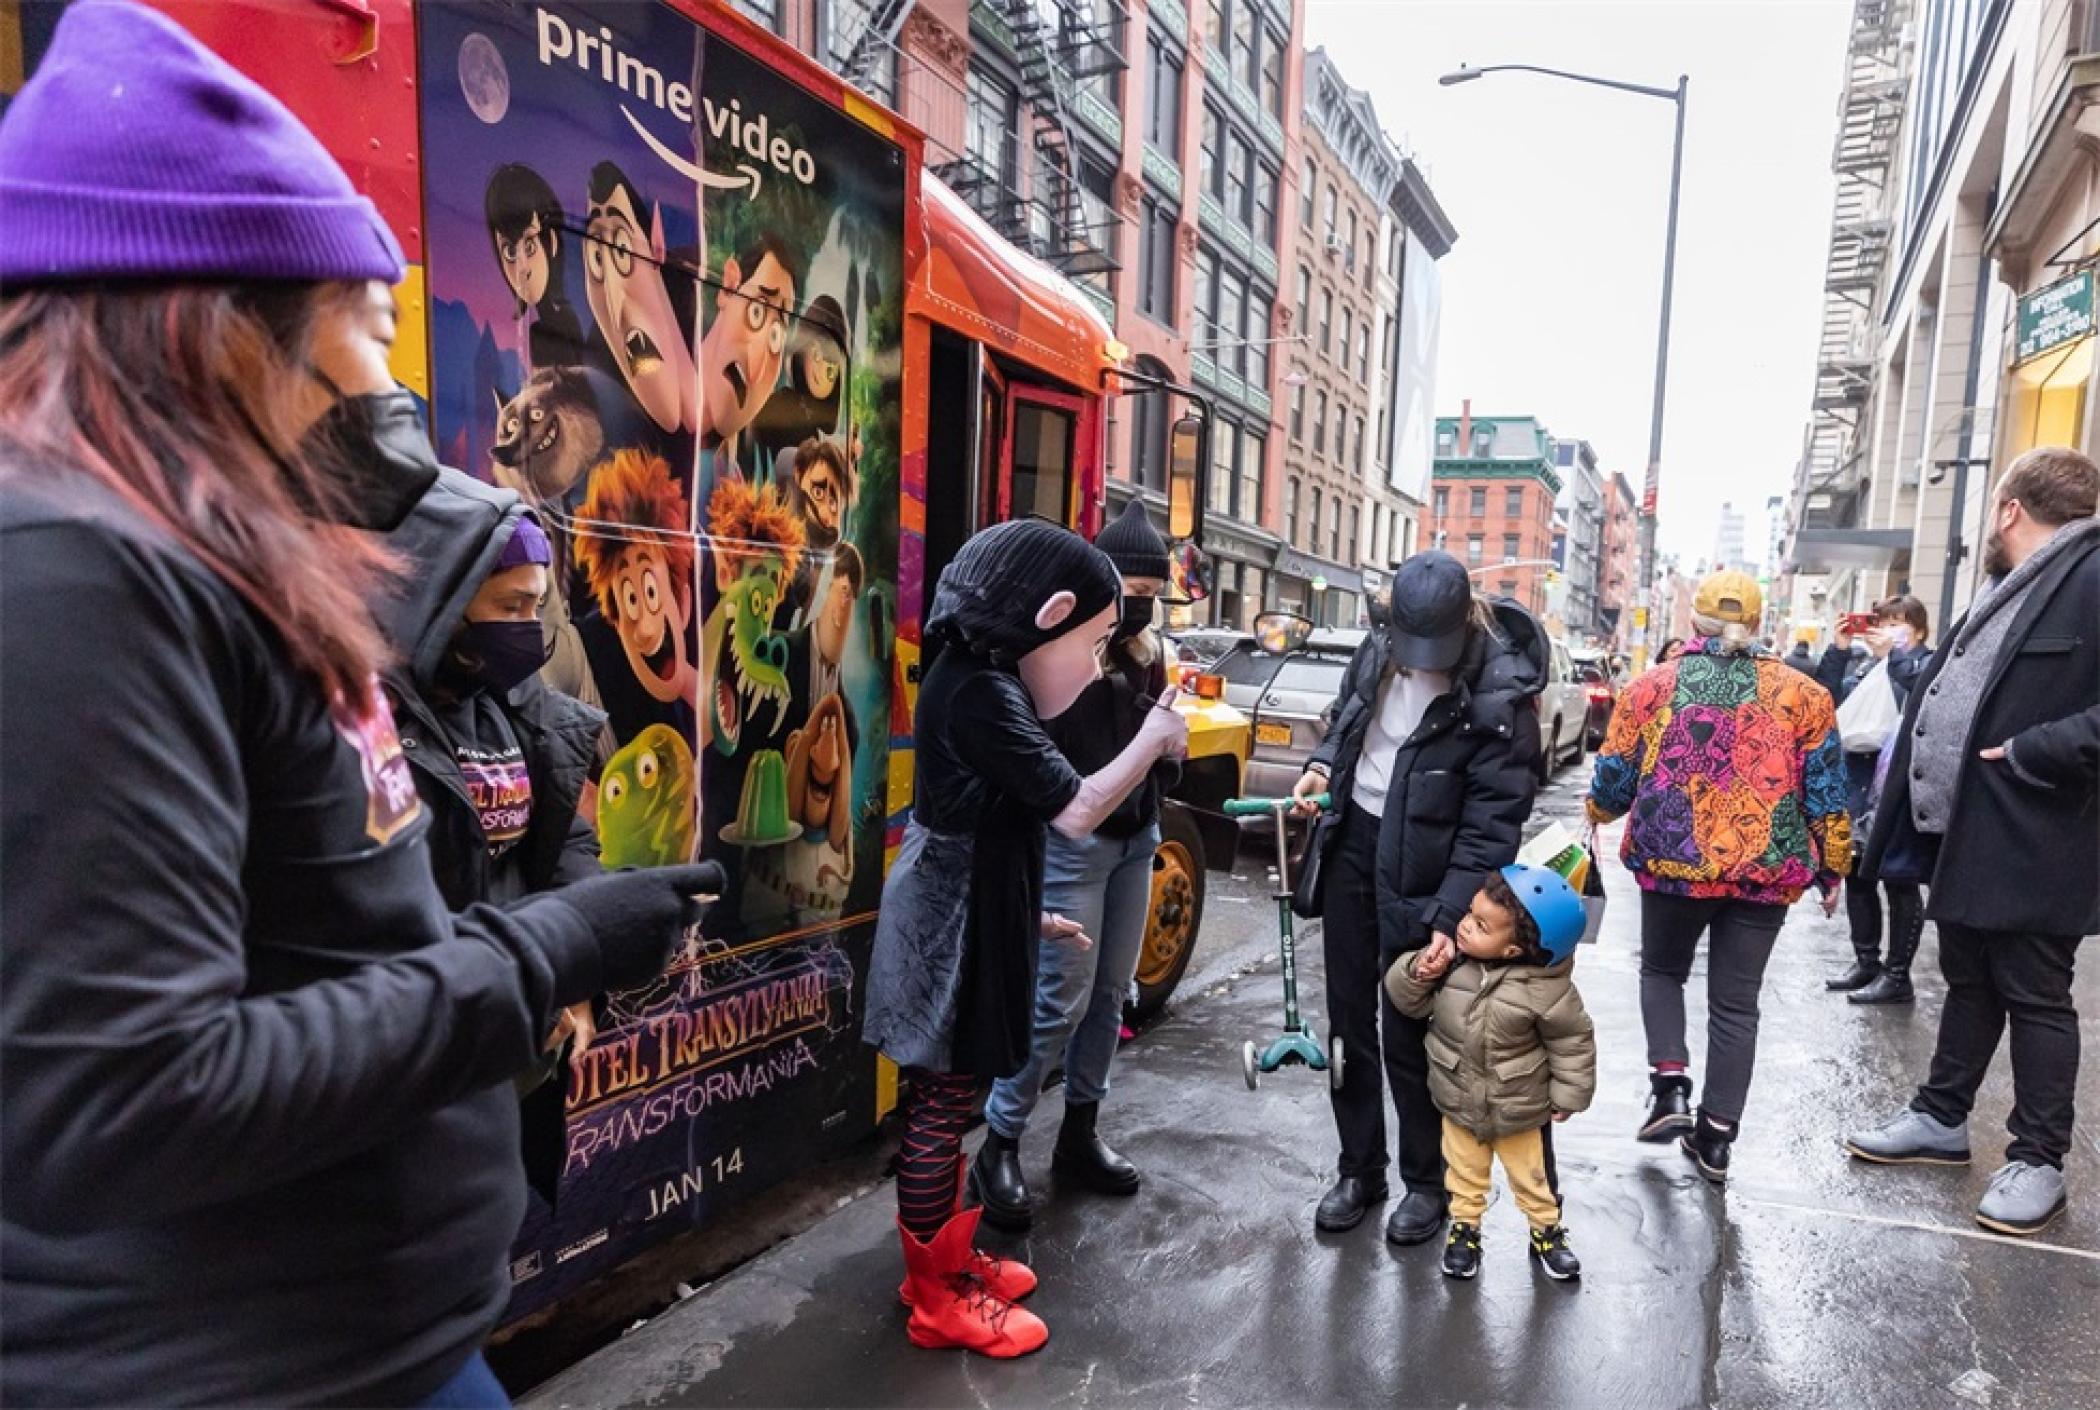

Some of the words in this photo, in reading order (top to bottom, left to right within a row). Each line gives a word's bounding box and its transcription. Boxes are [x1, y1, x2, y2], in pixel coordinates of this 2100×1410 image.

[536, 7, 693, 124] prime
[702, 96, 816, 185] video
[651, 972, 829, 1081] TRANSYLVANIA
[562, 1036, 819, 1178] RANSFORMANIA
[644, 1166, 703, 1222] JAN
[711, 1146, 745, 1184] 14
